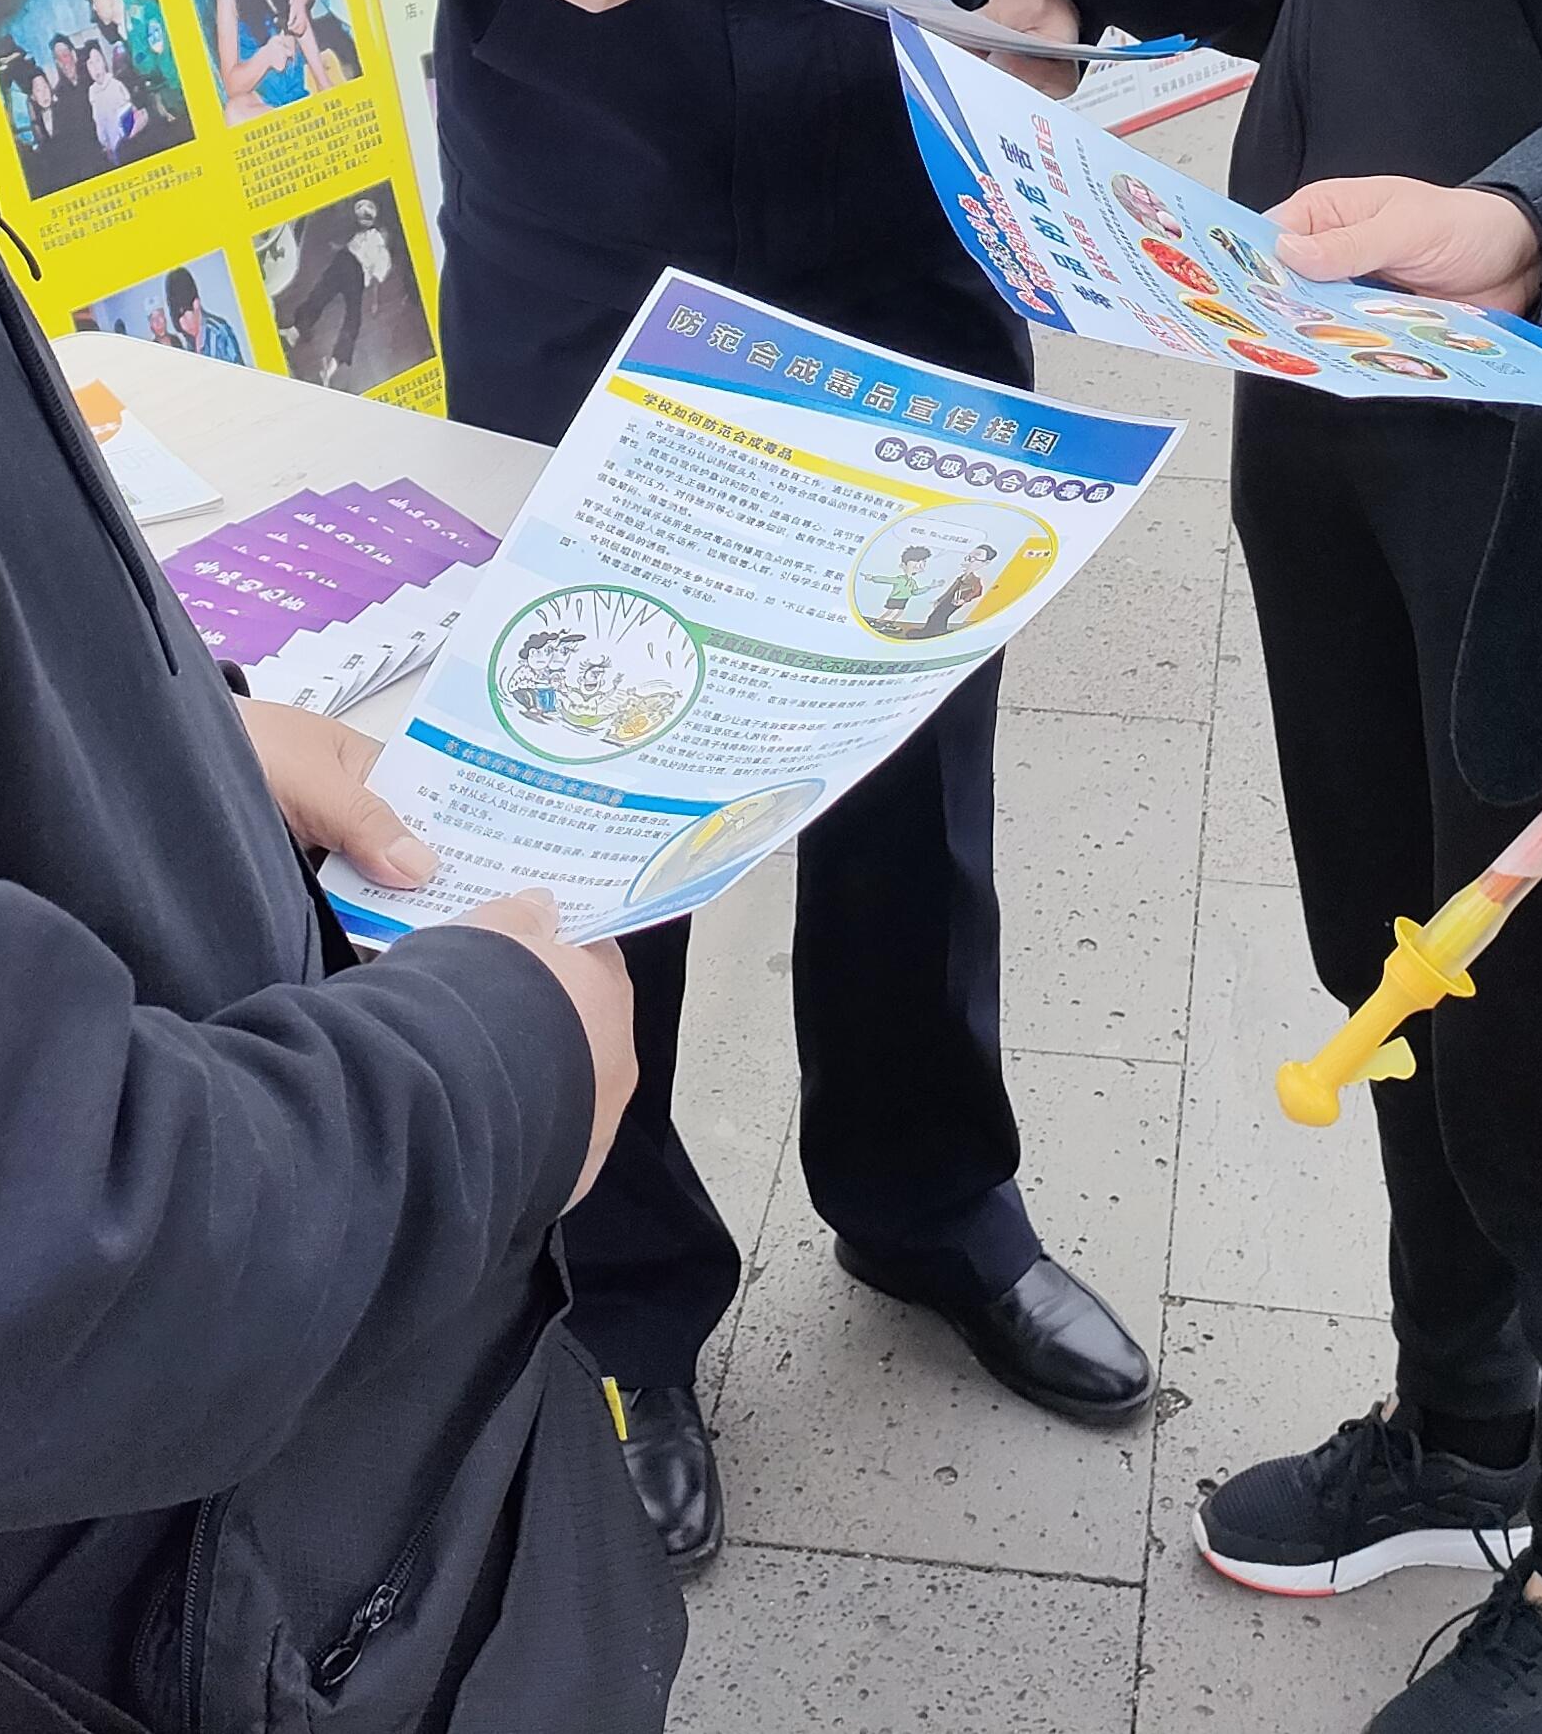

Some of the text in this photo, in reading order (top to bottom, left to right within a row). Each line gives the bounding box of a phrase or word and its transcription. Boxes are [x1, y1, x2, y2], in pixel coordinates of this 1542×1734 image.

[999, 133, 1115, 310] 毒品的危害
[642, 391, 794, 461] 学校如何防范合成毒品
[664, 302, 1061, 454] 防范合成毒品宣传挂图
[877, 439, 1115, 502] 防范吸食合成毒品
